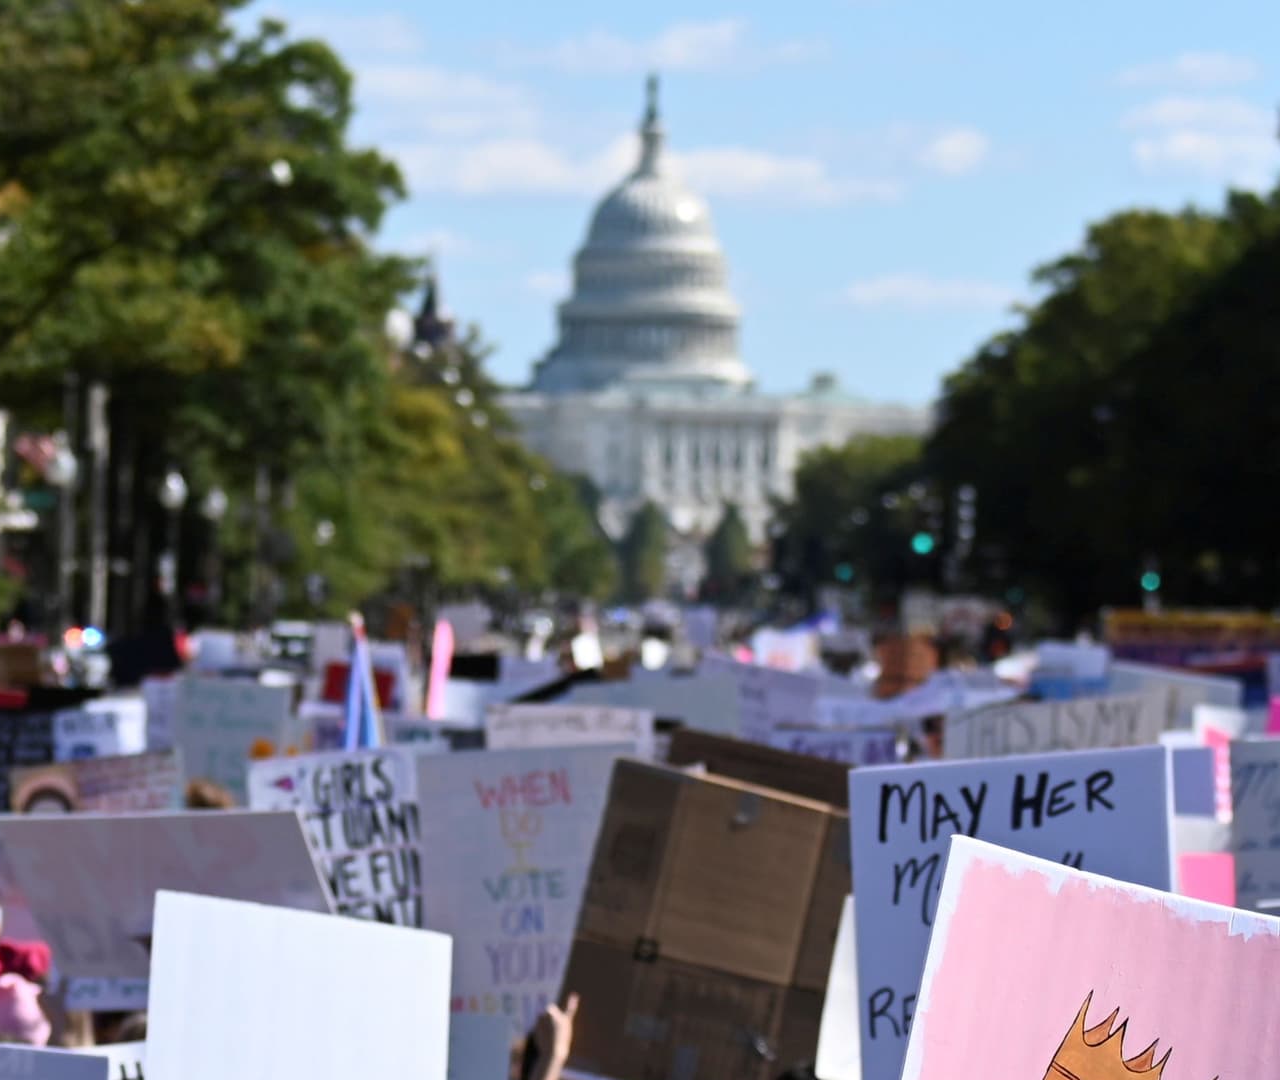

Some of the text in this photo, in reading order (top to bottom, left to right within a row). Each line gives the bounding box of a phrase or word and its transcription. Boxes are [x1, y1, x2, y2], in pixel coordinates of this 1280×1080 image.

[313, 757, 394, 806] GIRLS
[472, 768, 576, 810] WHEN
[499, 807, 546, 840] DO
[878, 769, 1117, 844] MAY HER
[504, 838, 543, 876] I
[482, 869, 568, 903] VOTE
[500, 906, 546, 937] ON
